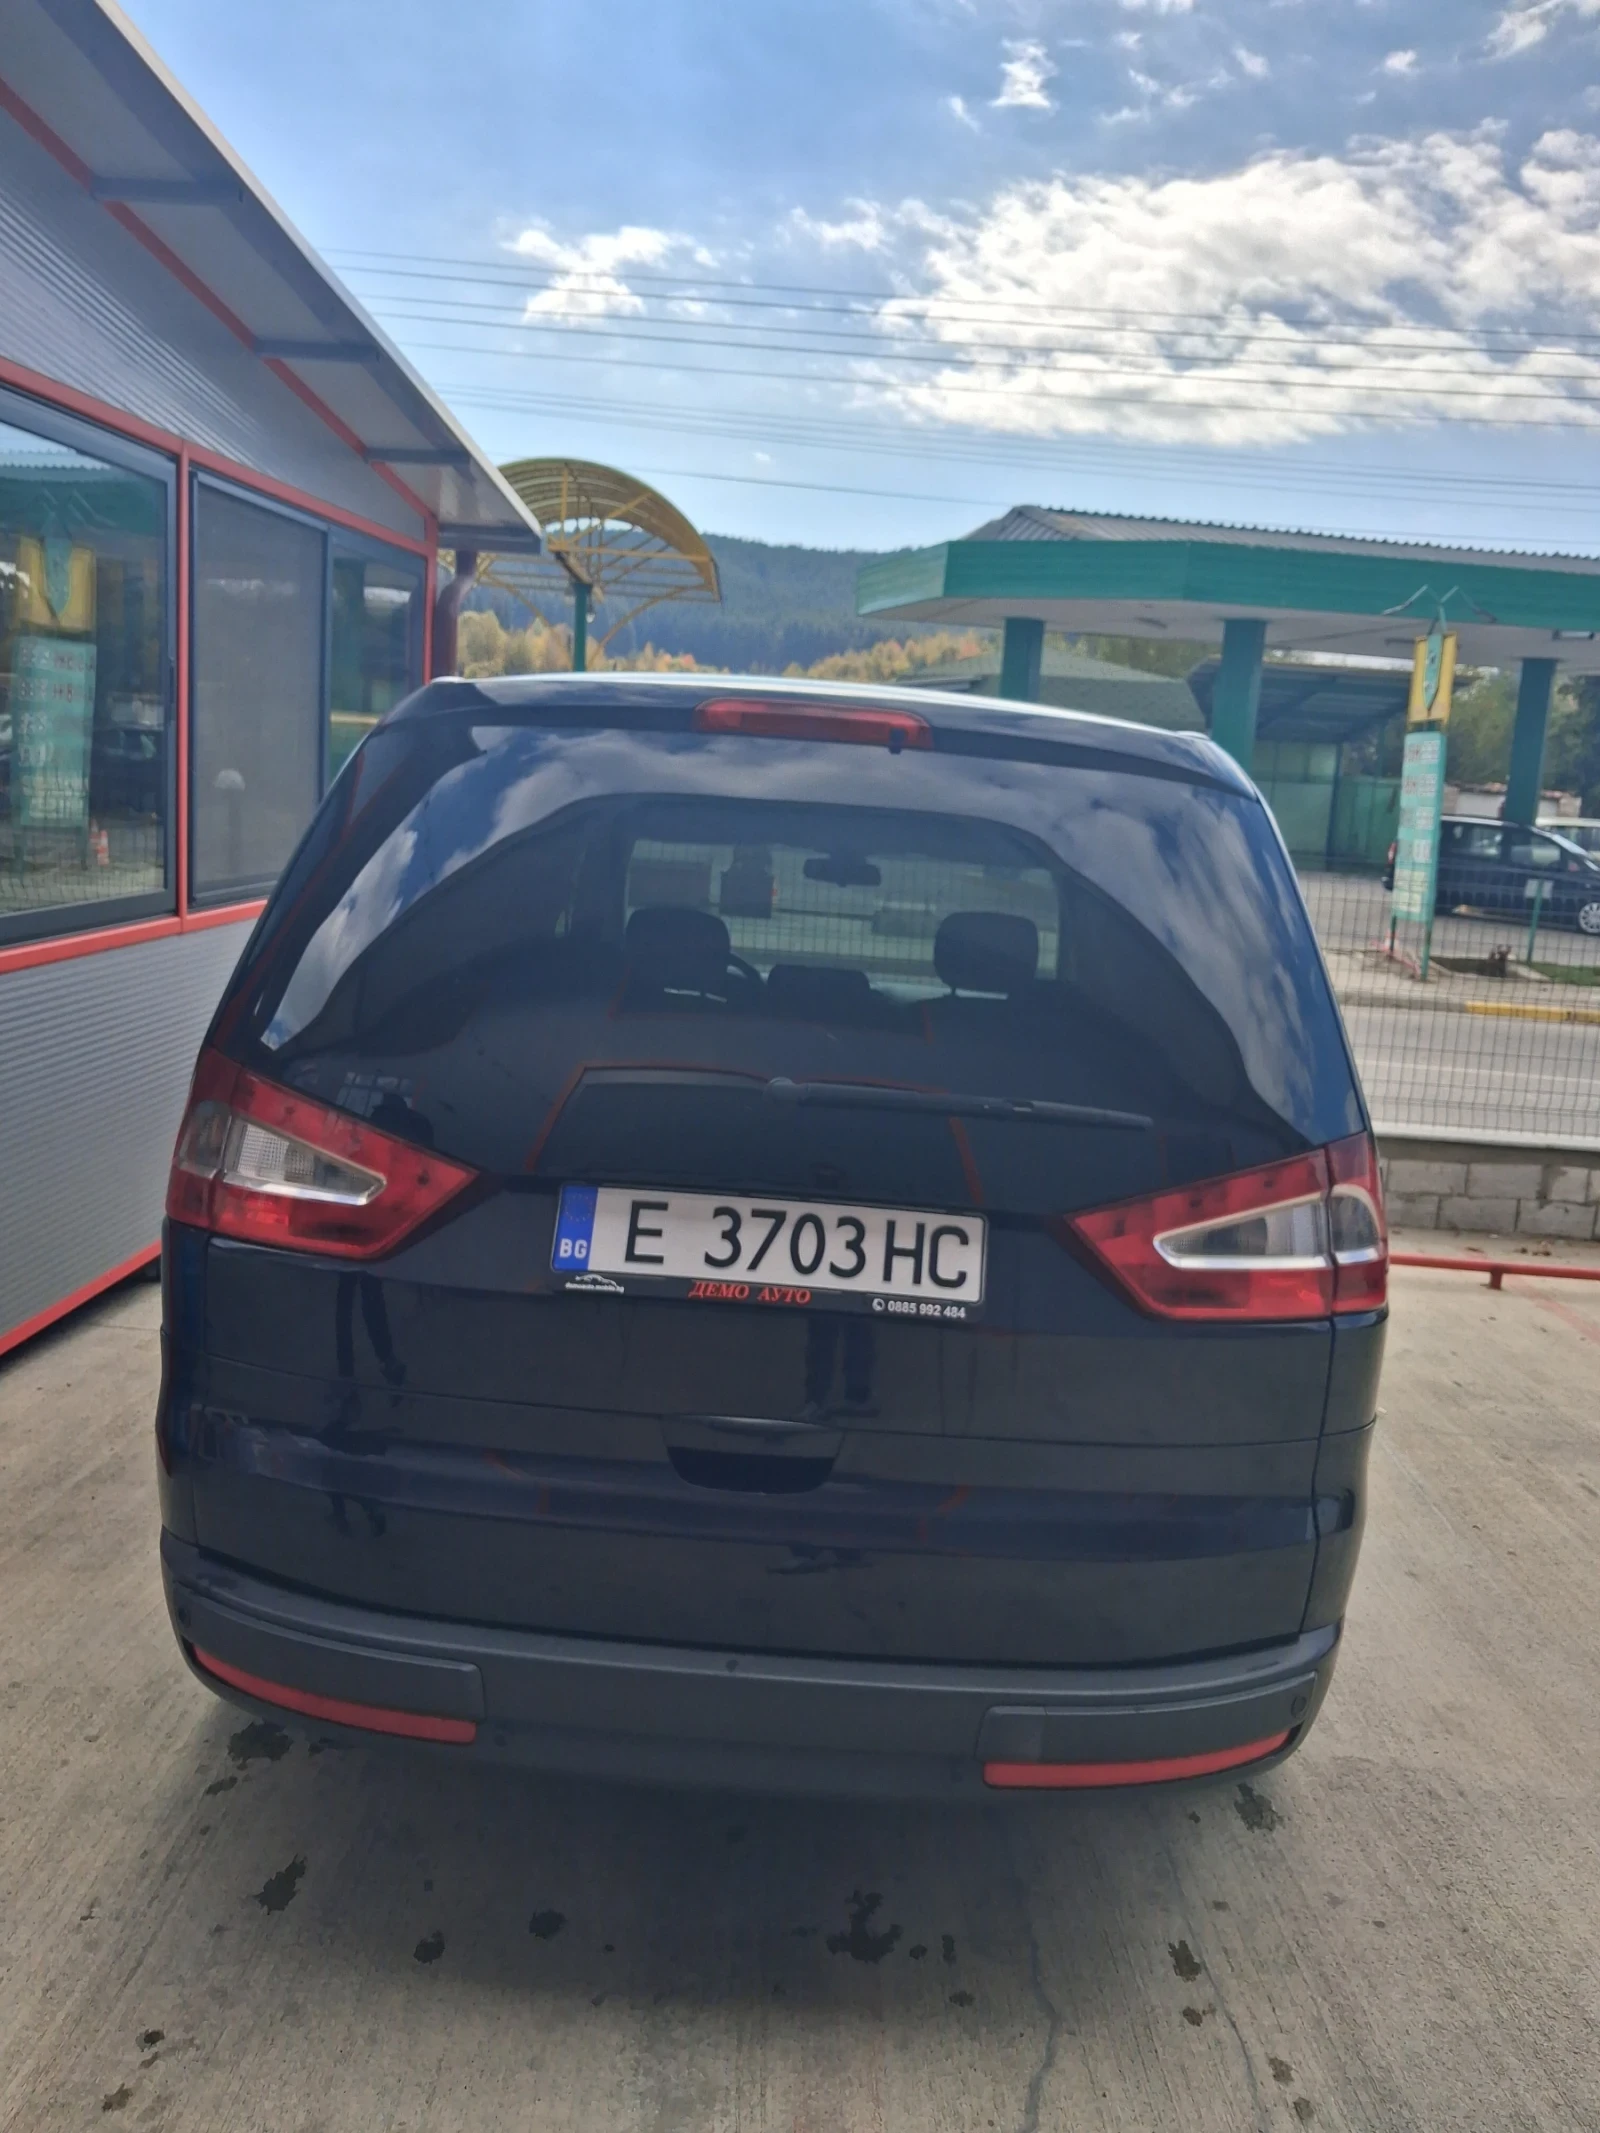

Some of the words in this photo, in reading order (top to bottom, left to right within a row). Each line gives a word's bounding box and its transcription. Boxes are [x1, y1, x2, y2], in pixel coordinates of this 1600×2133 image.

[625, 1200, 669, 1264] E
[559, 1238, 588, 1258] BG
[687, 1280, 750, 1300] ДЕМО
[756, 1286, 812, 1305] АУТО
[887, 1300, 917, 1314] 0885
[919, 1303, 941, 1316] 992
[943, 1306, 966, 1318] 484
